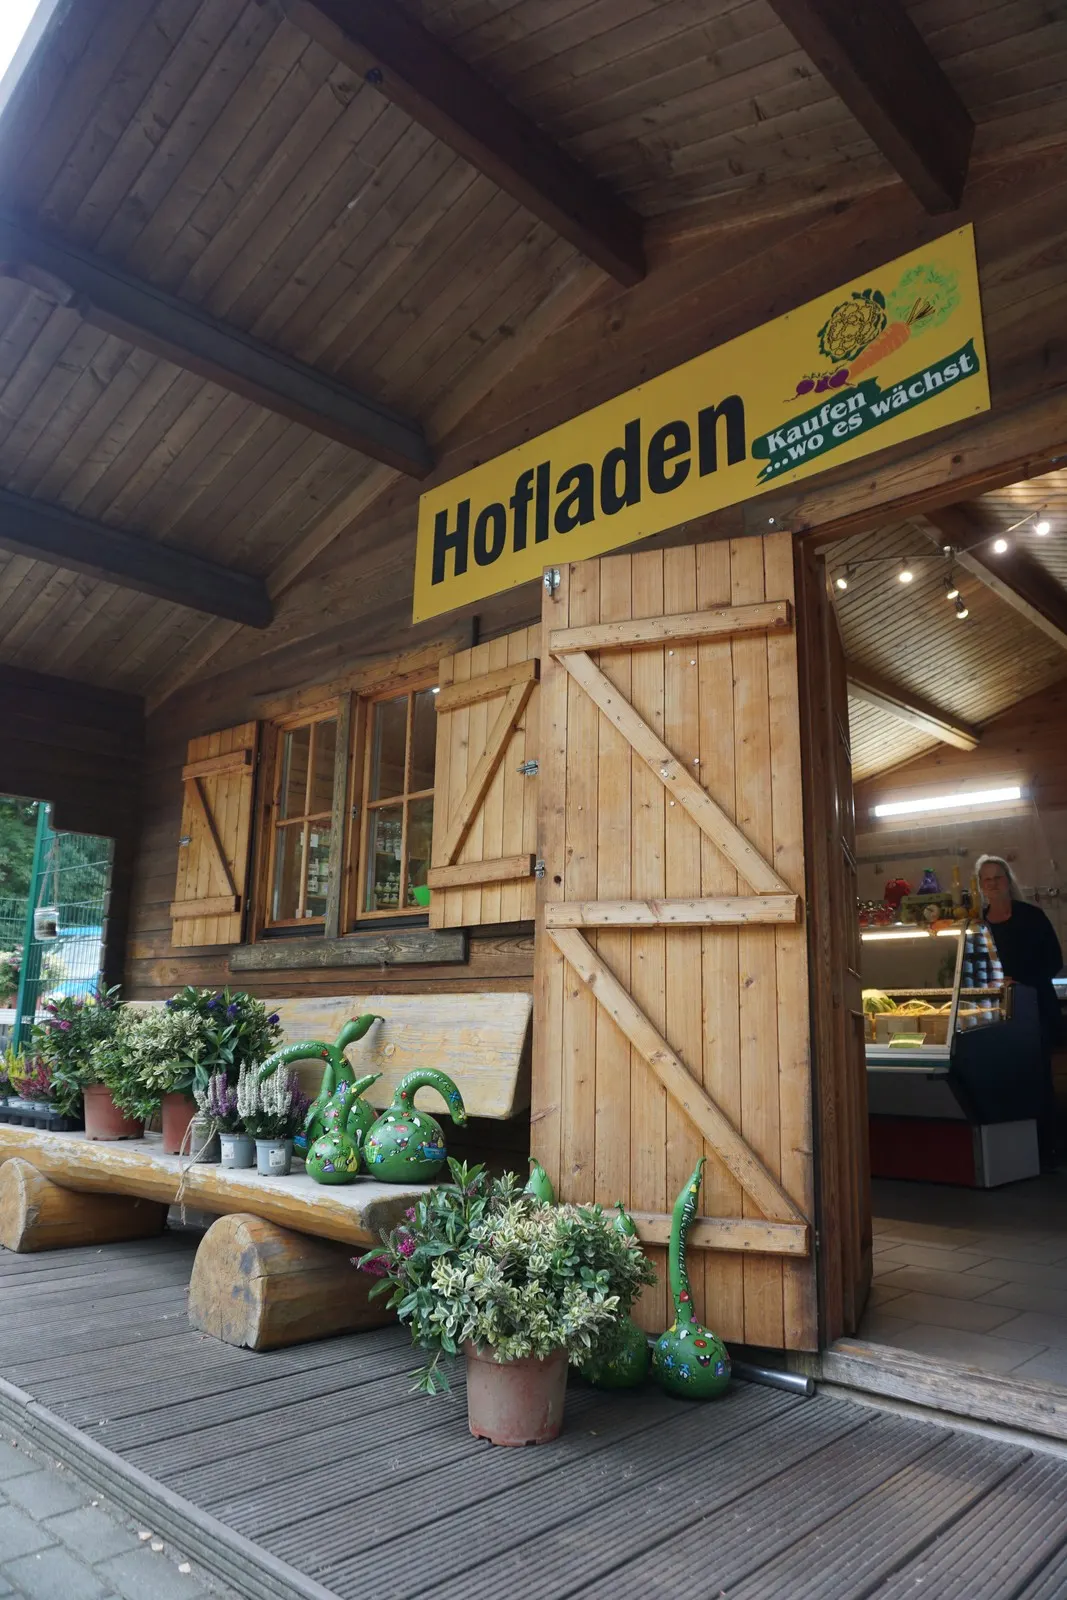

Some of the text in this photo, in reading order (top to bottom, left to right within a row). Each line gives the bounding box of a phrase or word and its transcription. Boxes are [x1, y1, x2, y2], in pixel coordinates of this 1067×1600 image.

[766, 391, 867, 454] Kaufen
[831, 412, 863, 438] es
[869, 353, 974, 418] wächst
[431, 394, 746, 586] Hofladen
